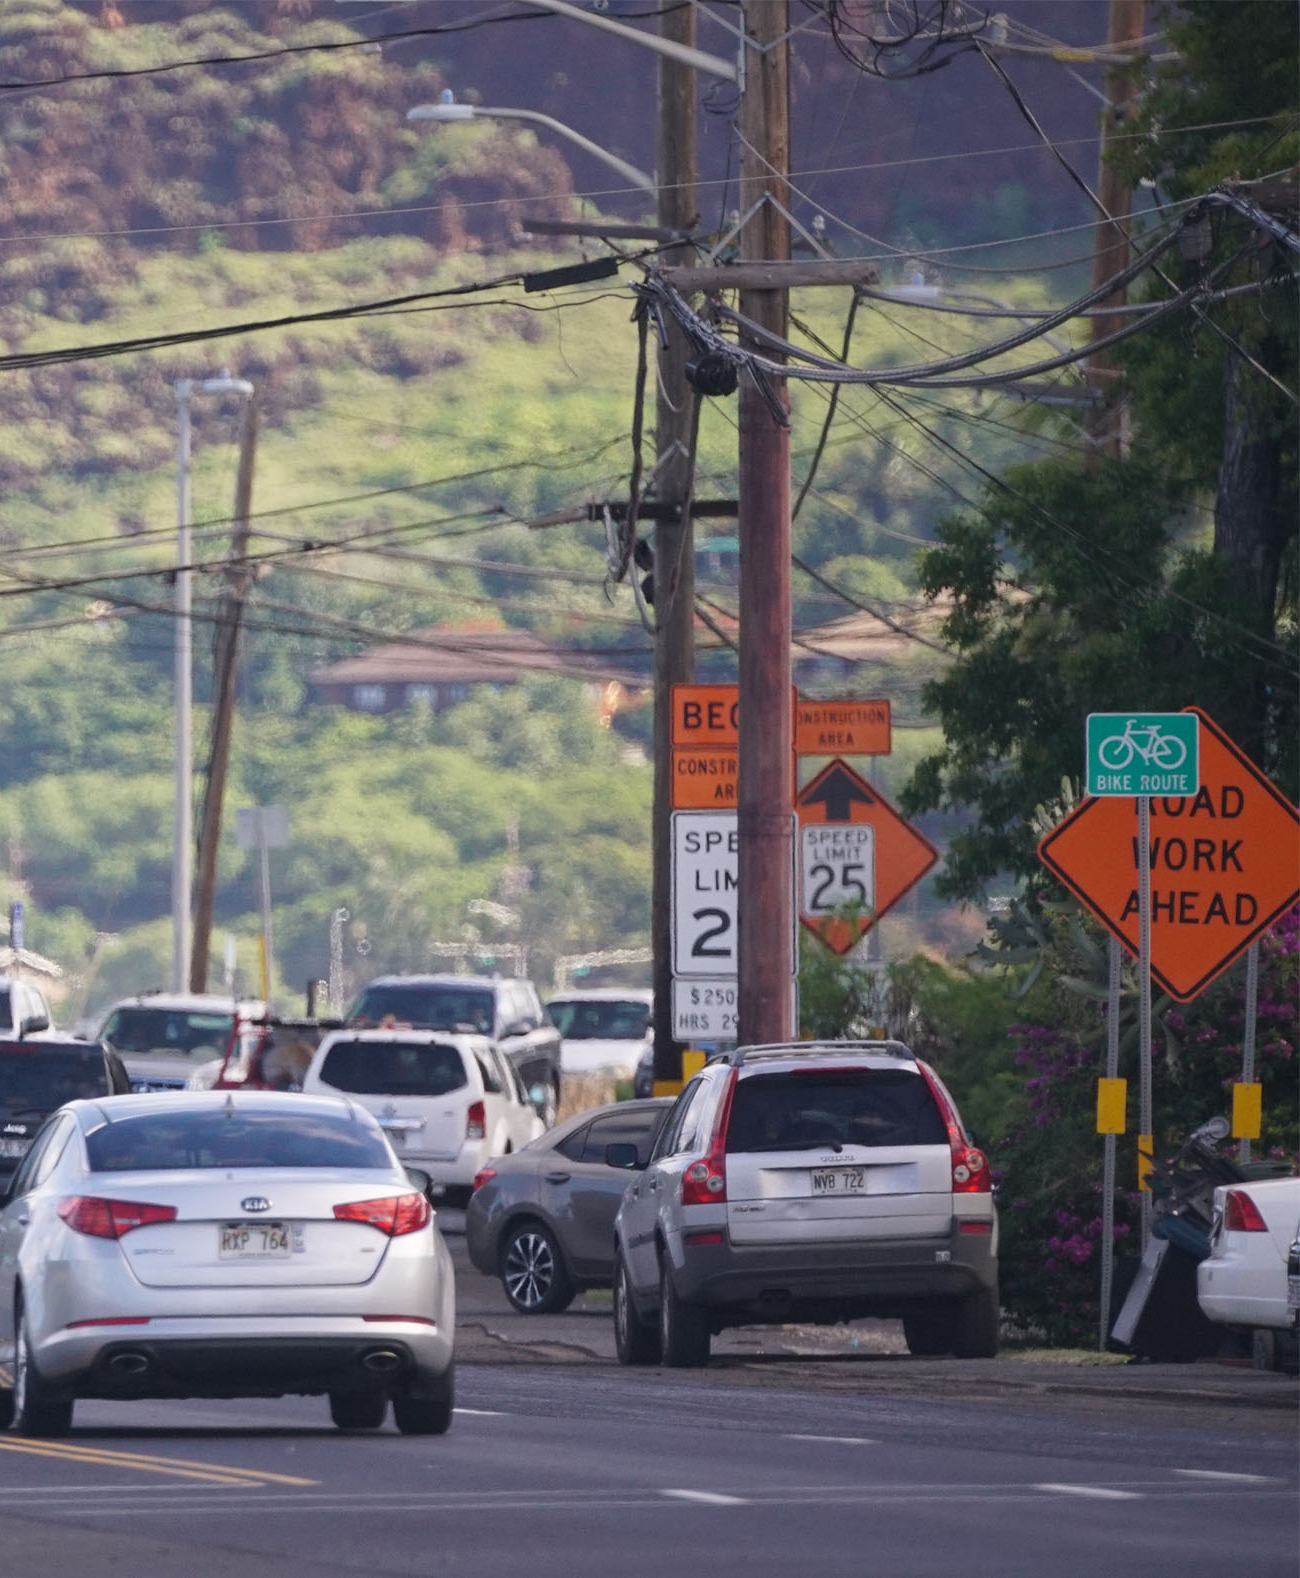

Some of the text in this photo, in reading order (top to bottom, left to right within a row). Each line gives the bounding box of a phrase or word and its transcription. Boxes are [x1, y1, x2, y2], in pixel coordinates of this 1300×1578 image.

[818, 732, 854, 745] AREA
[1097, 775, 1188, 791] BIKE ROUTE
[808, 831, 868, 845] SPEED
[814, 847, 860, 860] LIMIT
[1132, 836, 1243, 872] WORK
[810, 864, 866, 909] 25
[1119, 889, 1258, 925] AHEAD
[692, 906, 731, 957] 2
[691, 986, 735, 1006] $250
[679, 1013, 709, 1030] HRS
[814, 1173, 864, 1189] NVB 722
[243, 1198, 269, 1210] KIA
[222, 1231, 250, 1251] RXP
[260, 1231, 288, 1251] 764
